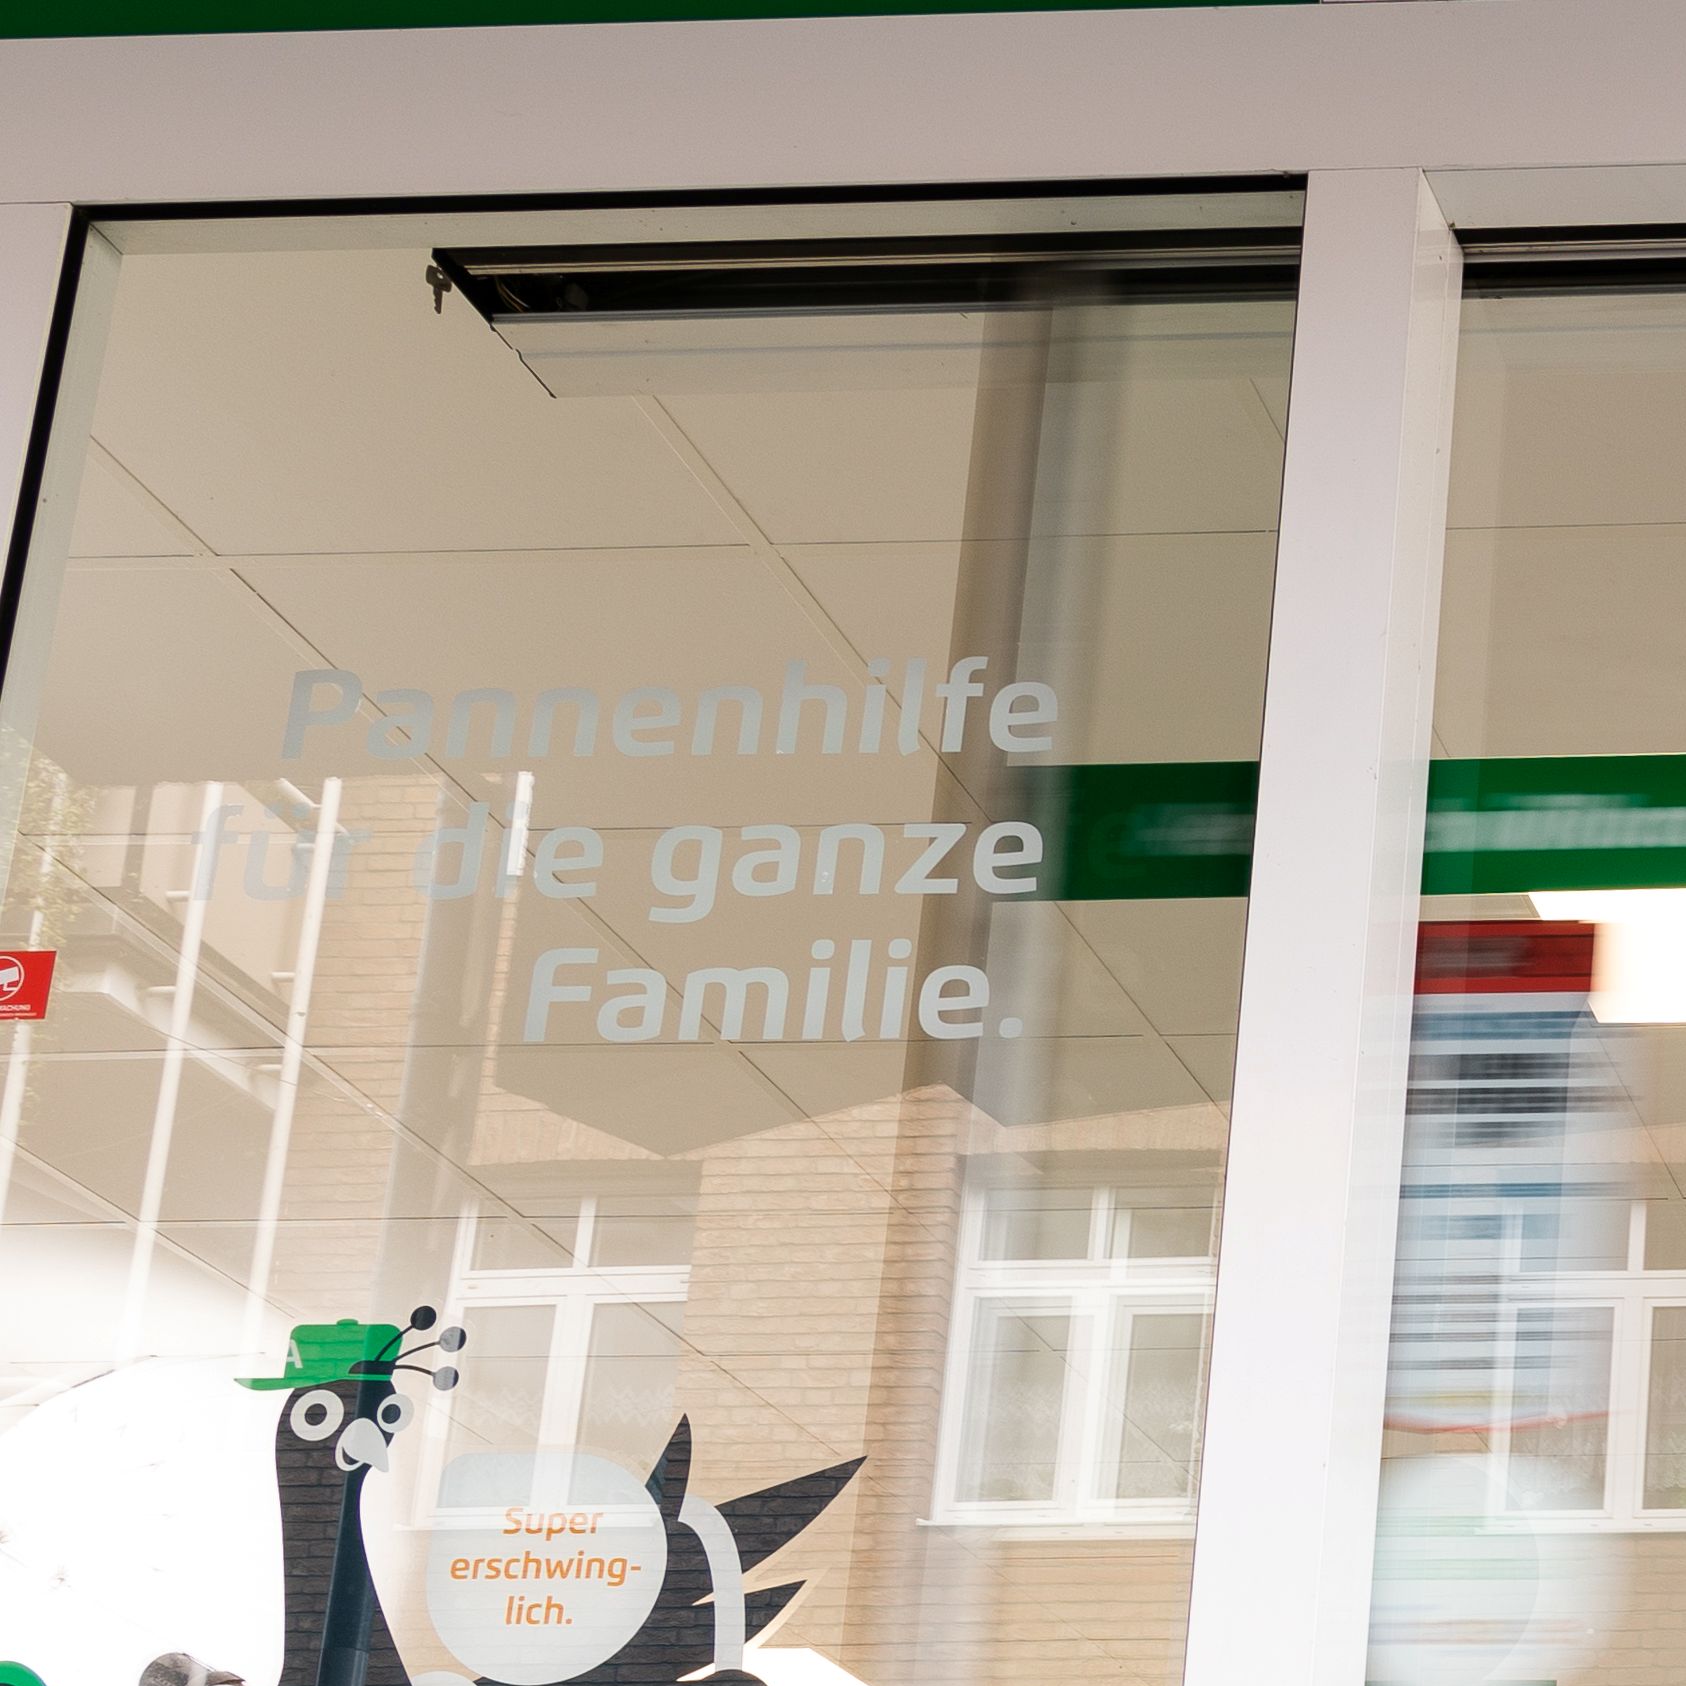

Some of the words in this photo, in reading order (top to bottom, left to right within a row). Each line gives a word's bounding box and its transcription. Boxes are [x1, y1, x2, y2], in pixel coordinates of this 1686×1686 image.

[279, 655, 1061, 761] Pannenhilfe
[192, 802, 372, 902] für
[412, 801, 604, 900] die
[649, 815, 1046, 925] ganze
[522, 939, 1024, 1044] Familie.
[502, 1506, 603, 1546] Super
[449, 1549, 643, 1588] erschwing-
[504, 1594, 574, 1627] lich.
